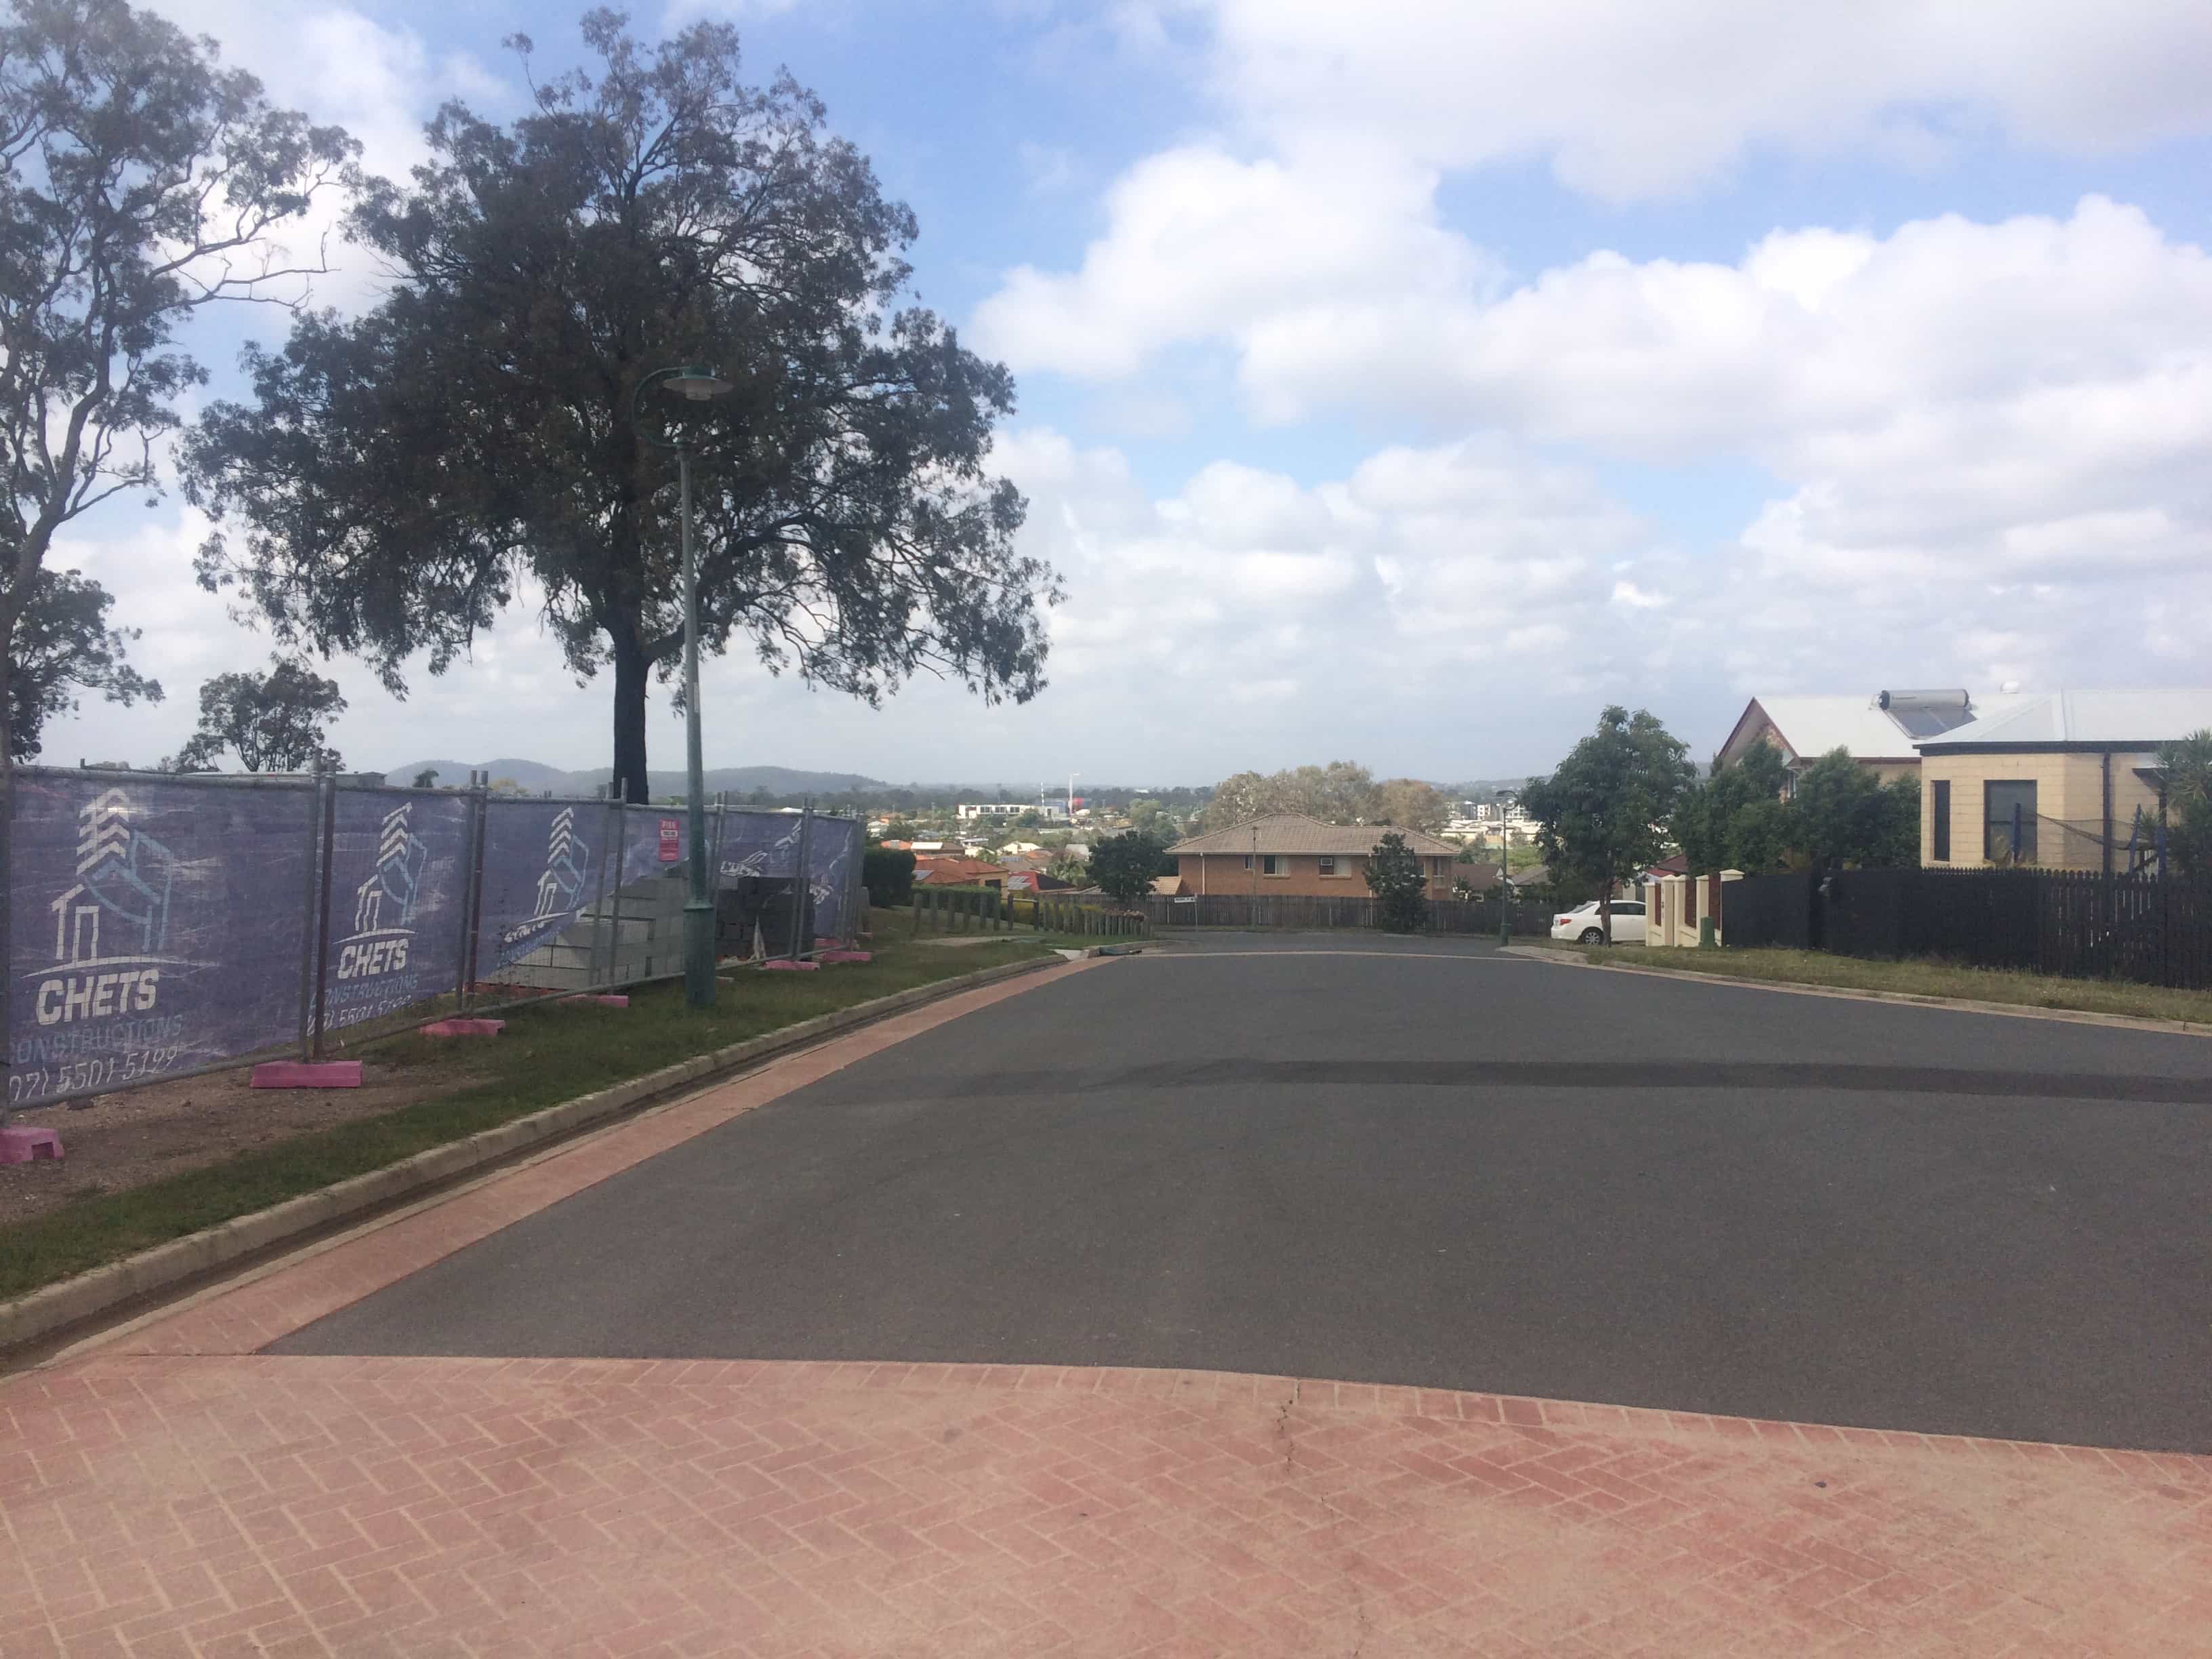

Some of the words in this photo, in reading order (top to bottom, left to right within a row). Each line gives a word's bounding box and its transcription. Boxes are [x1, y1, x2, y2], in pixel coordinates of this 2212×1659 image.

[337, 938, 409, 979] CHETS
[36, 969, 159, 1025] CHETS
[9, 1014, 186, 1065] ONSTRUCTIONS
[55, 1057, 115, 1094] 5501
[121, 1046, 179, 1081] 5199
